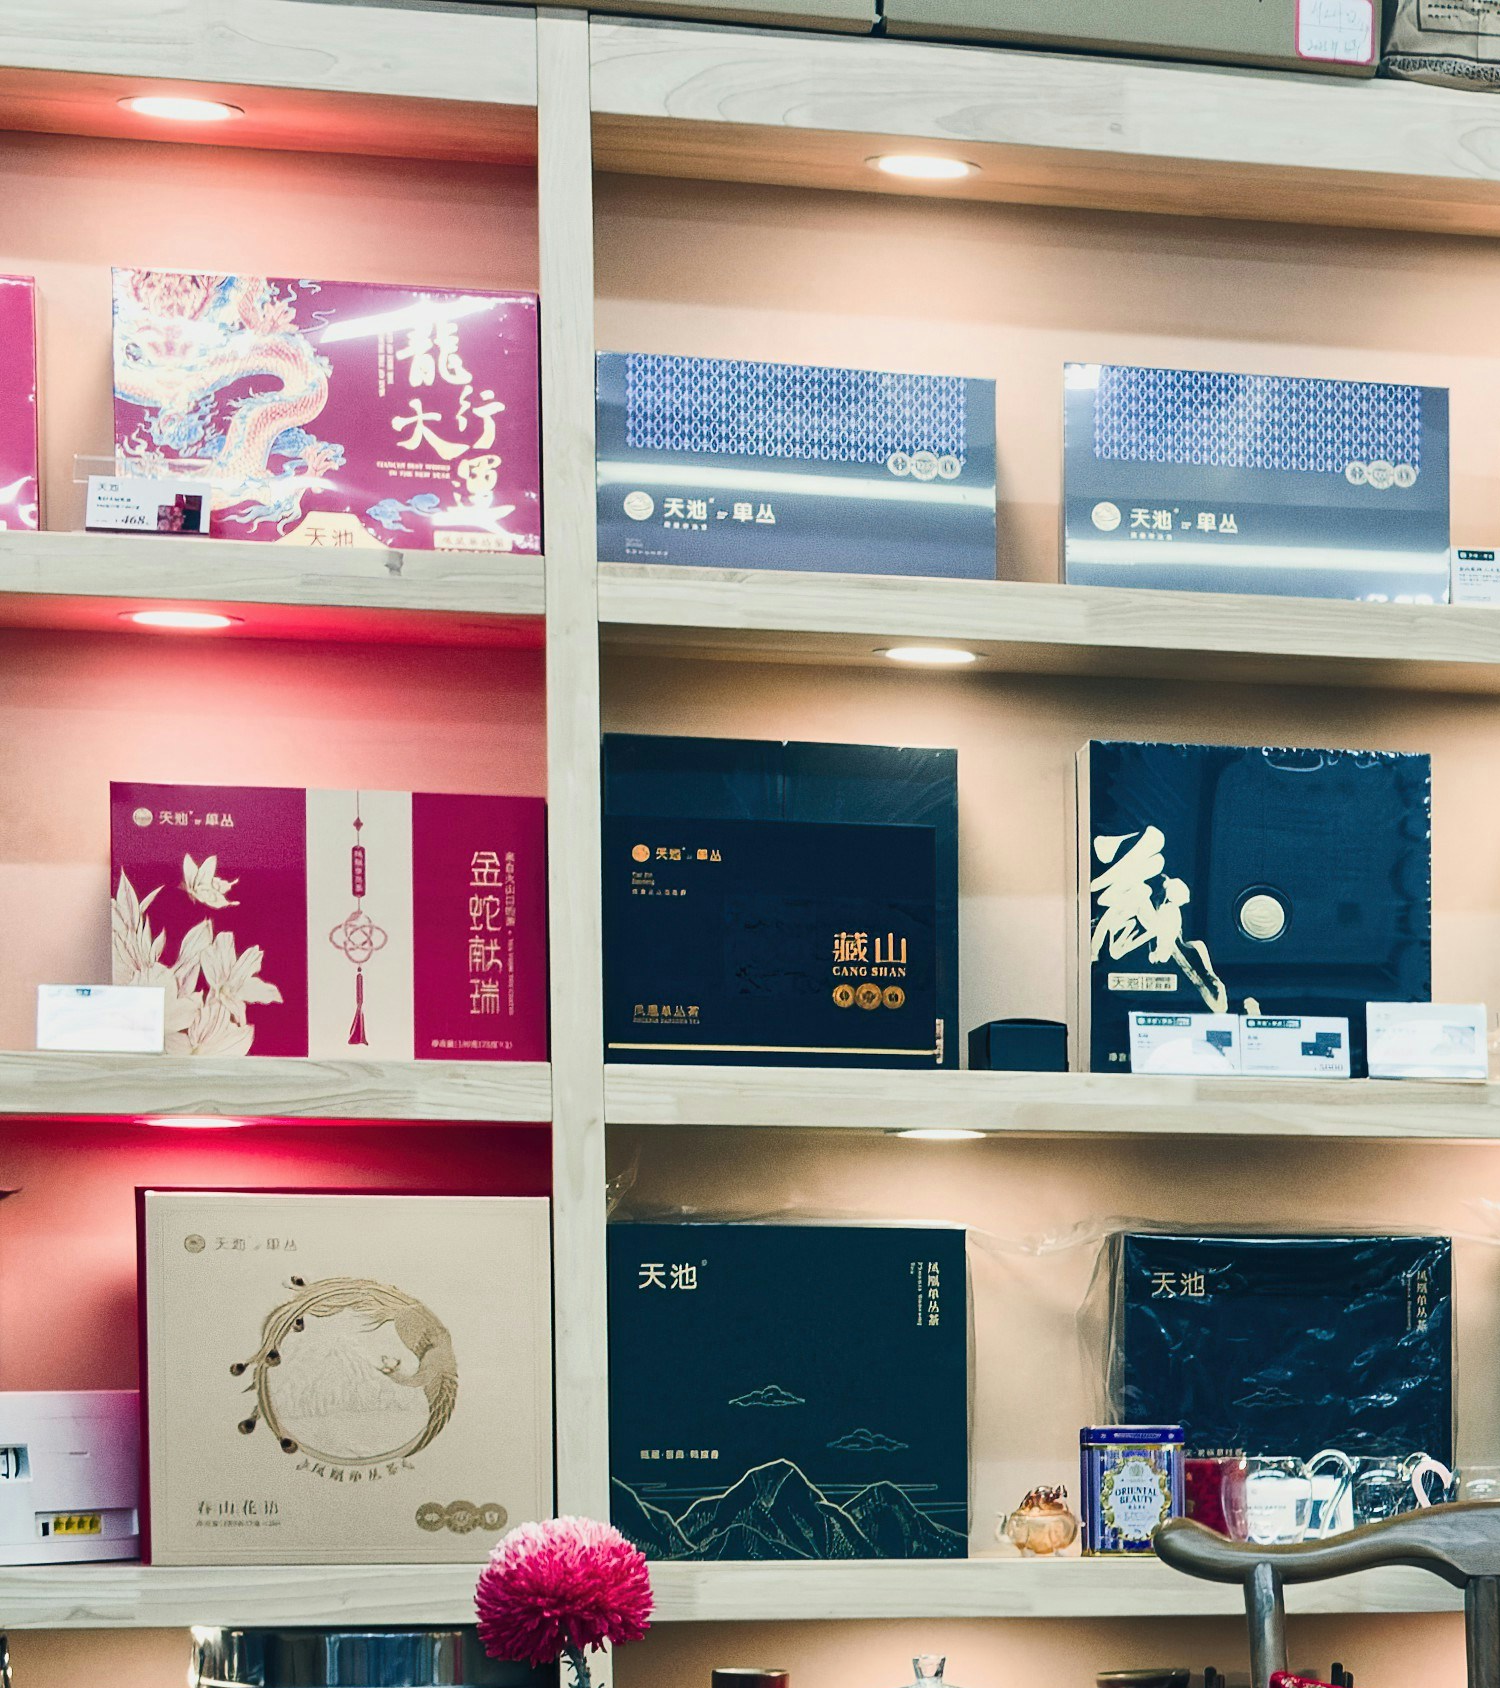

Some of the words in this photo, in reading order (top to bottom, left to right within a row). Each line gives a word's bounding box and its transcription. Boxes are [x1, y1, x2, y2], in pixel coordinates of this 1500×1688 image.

[663, 497, 708, 520] 天池
[733, 502, 776, 525] 单丛
[1130, 508, 1173, 531] 天池
[1197, 512, 1239, 534] 单丛
[469, 850, 503, 1016] 金蛇献瑞
[832, 931, 907, 964] 藏山
[832, 965, 868, 977] CANG
[871, 966, 906, 978] SHAN
[638, 1263, 697, 1290] 天池
[1151, 1271, 1206, 1298] 天池
[1114, 1485, 1159, 1497] ORIENTAL
[1118, 1494, 1154, 1505] BEAUTY
